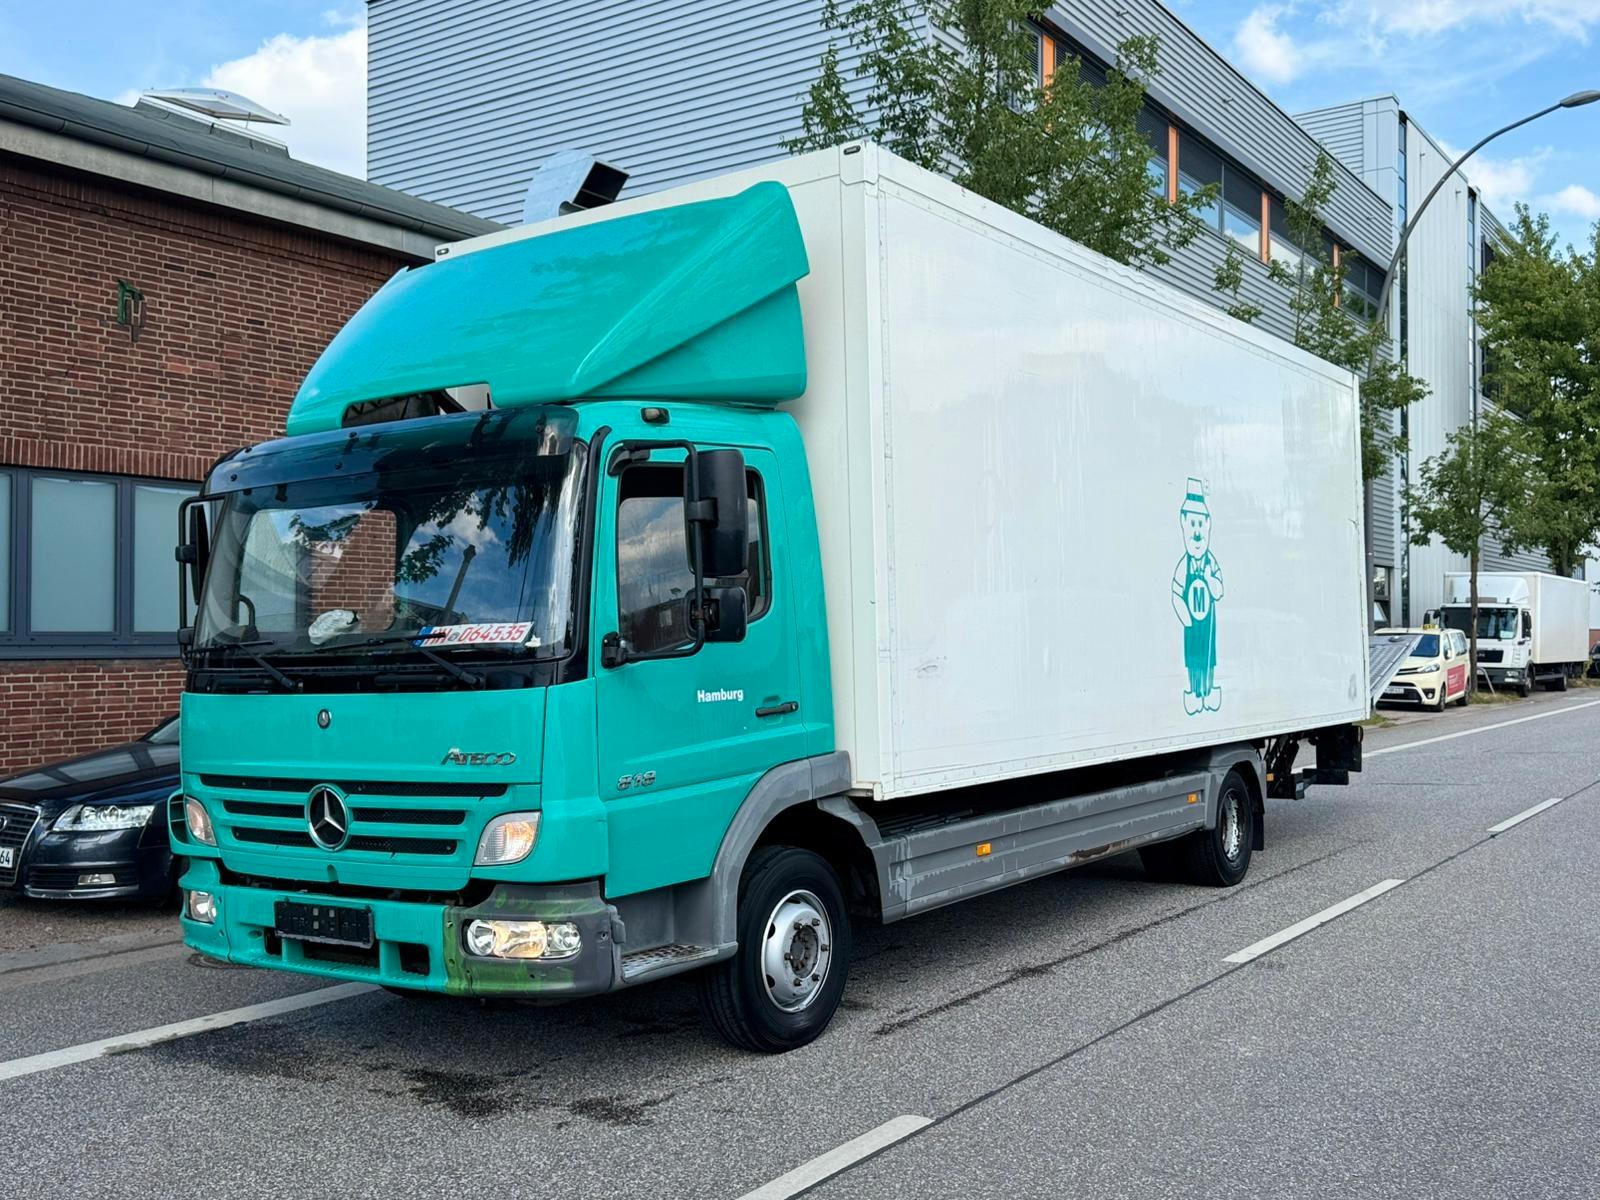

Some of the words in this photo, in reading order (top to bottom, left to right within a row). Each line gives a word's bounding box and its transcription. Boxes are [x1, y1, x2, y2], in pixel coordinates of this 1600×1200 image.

[1193, 586, 1205, 612] M
[458, 624, 528, 642] 064535
[697, 688, 744, 703] Hamburg
